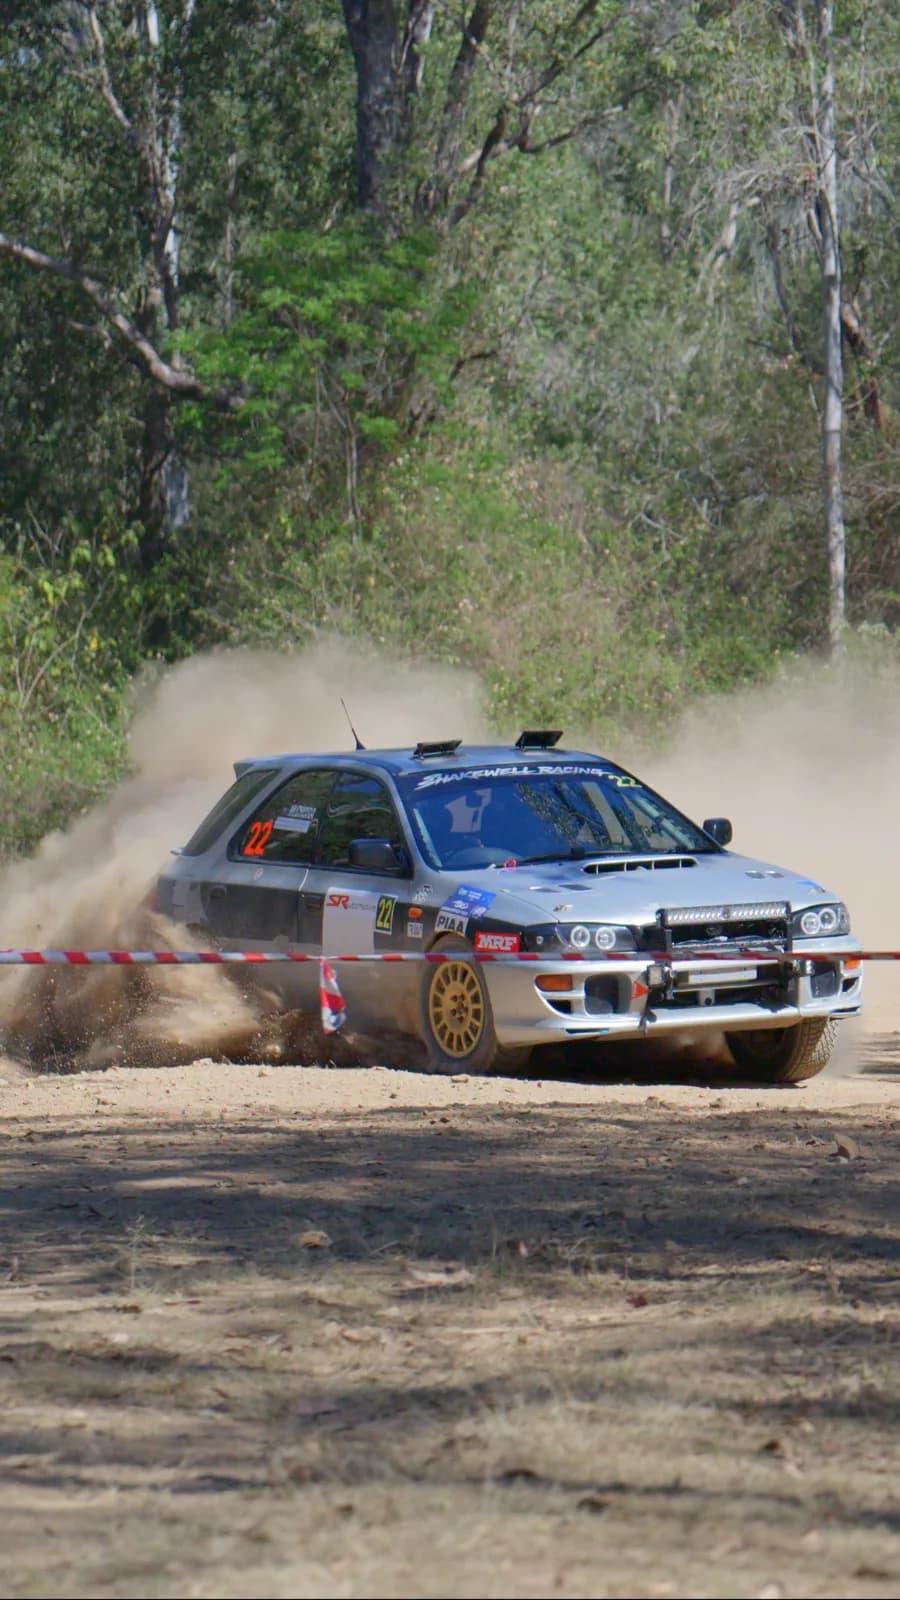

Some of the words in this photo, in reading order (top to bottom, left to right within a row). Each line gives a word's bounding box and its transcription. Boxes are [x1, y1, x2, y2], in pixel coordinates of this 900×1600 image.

[415, 766, 536, 790] SHAKEWELL
[537, 765, 612, 777] RACING
[608, 775, 643, 788] 22
[243, 820, 273, 856] 22
[327, 895, 350, 910] SR
[376, 898, 393, 929] 22
[437, 915, 464, 933] PIAA
[478, 935, 517, 951] MRF
